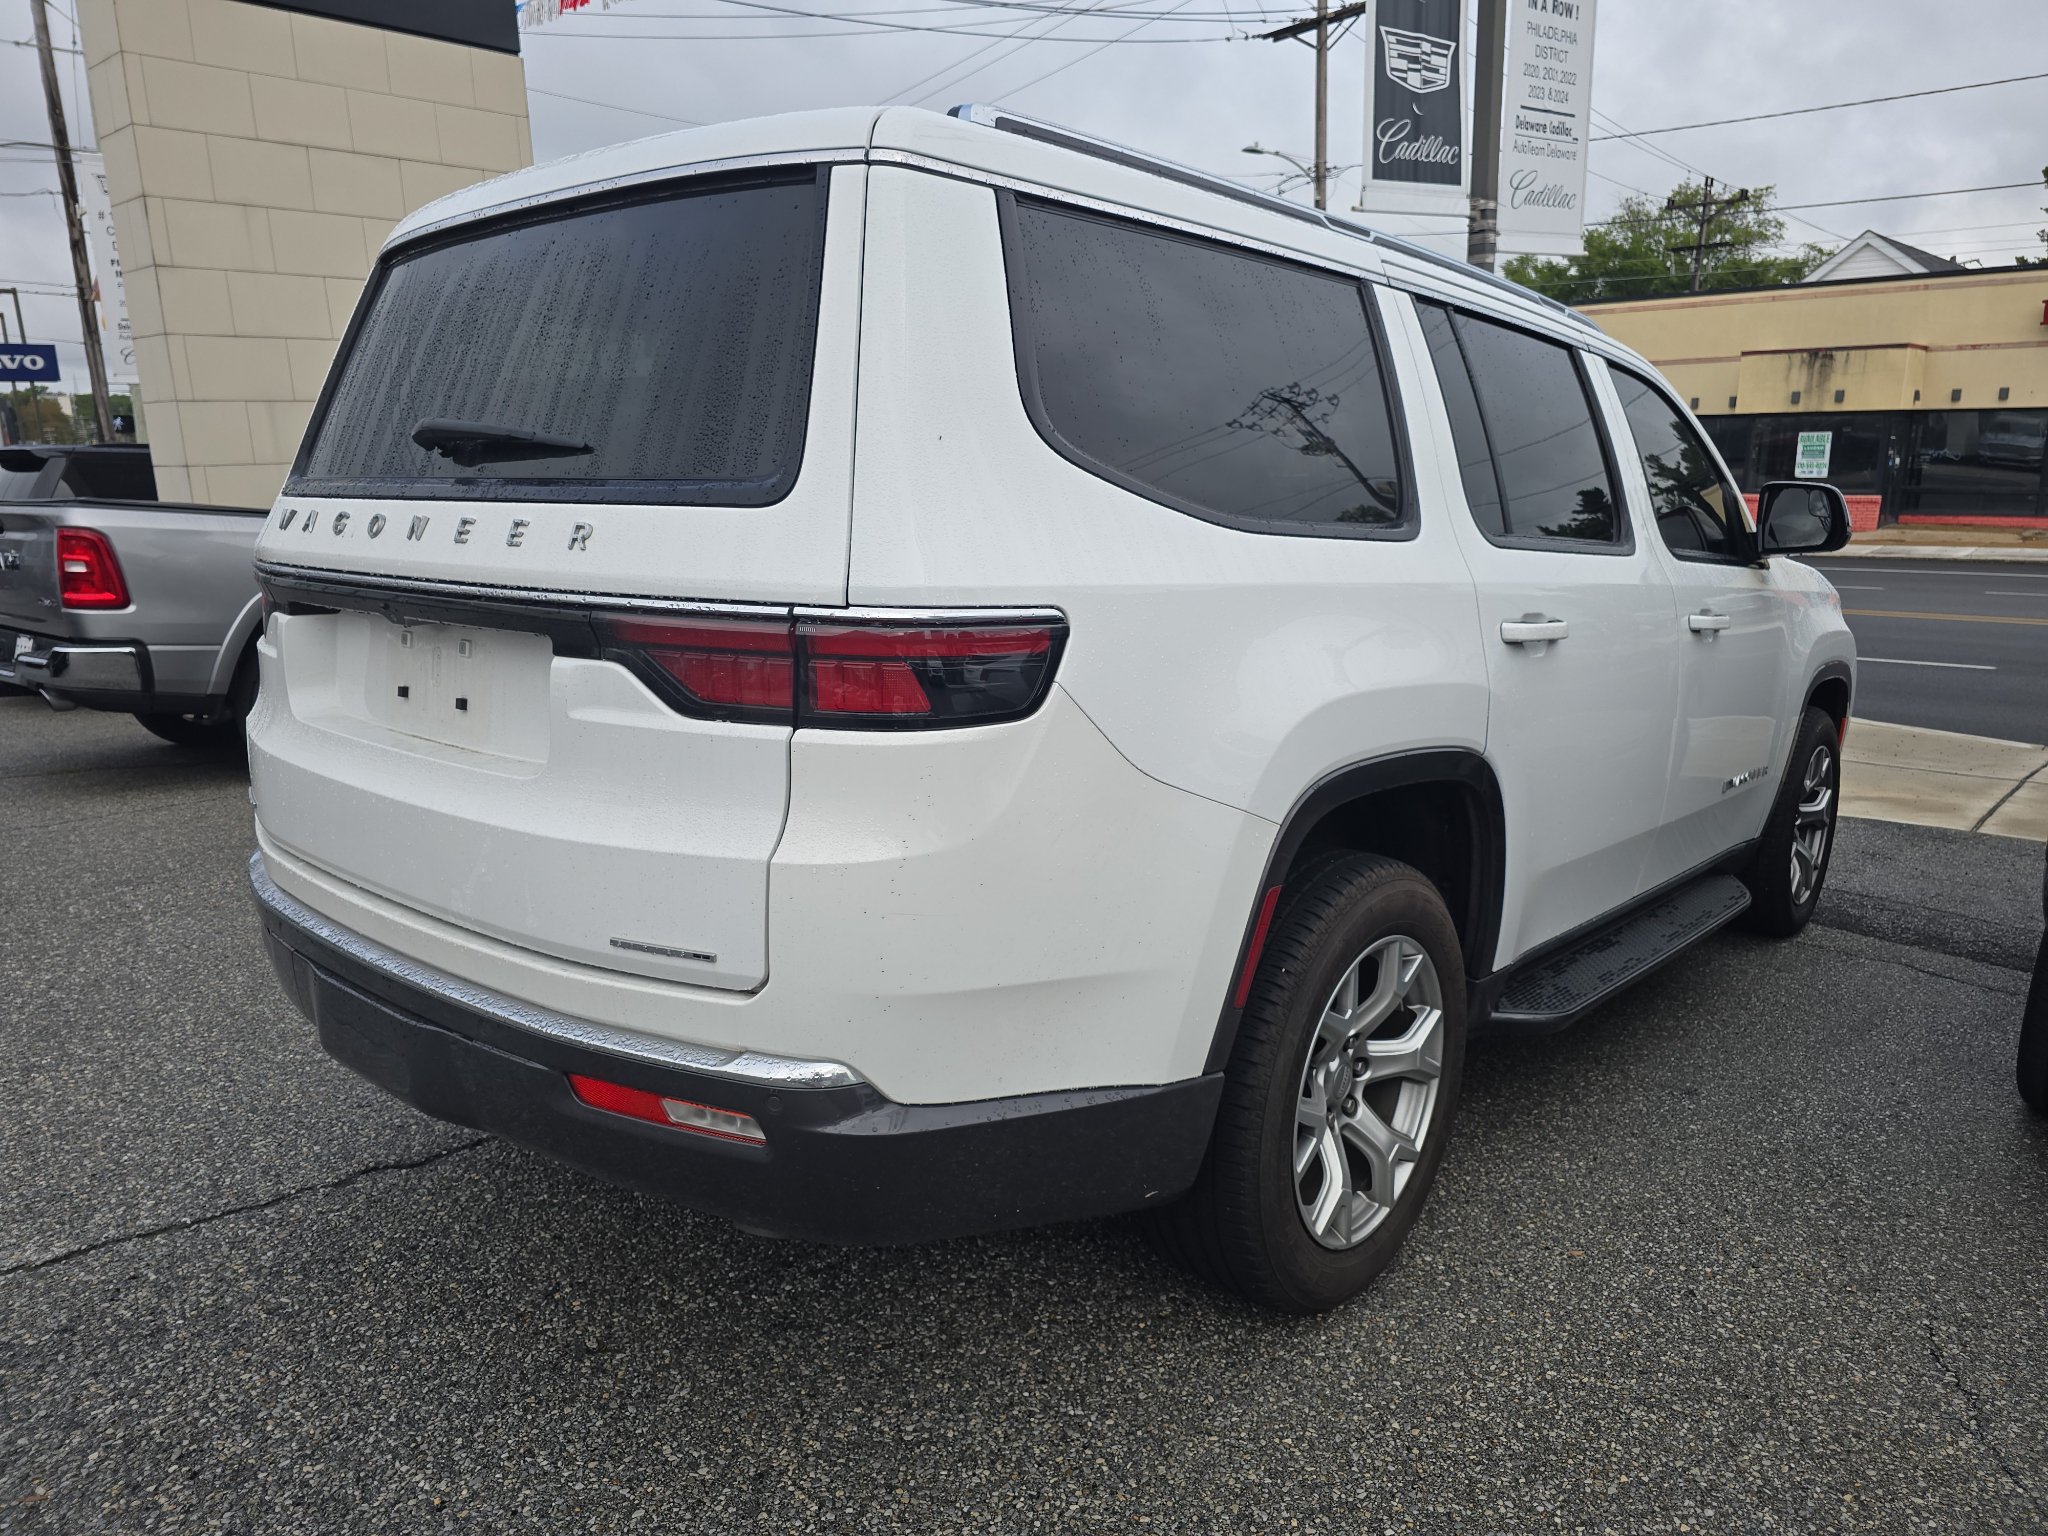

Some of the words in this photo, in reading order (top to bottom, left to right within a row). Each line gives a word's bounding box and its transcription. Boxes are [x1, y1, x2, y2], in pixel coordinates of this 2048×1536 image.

[1552, 0, 1574, 19] ROW
[1526, 21, 1578, 45] PHILADELPHIA
[1534, 44, 1569, 63] DISTRICT
[1515, 114, 1547, 134] Delaware
[1549, 121, 1573, 137] Cadillac
[1376, 117, 1460, 165] Cadillac
[1546, 142, 1578, 160] Delaware
[1509, 169, 1577, 210] Cadillac
[278, 508, 594, 551] WAGONEER
